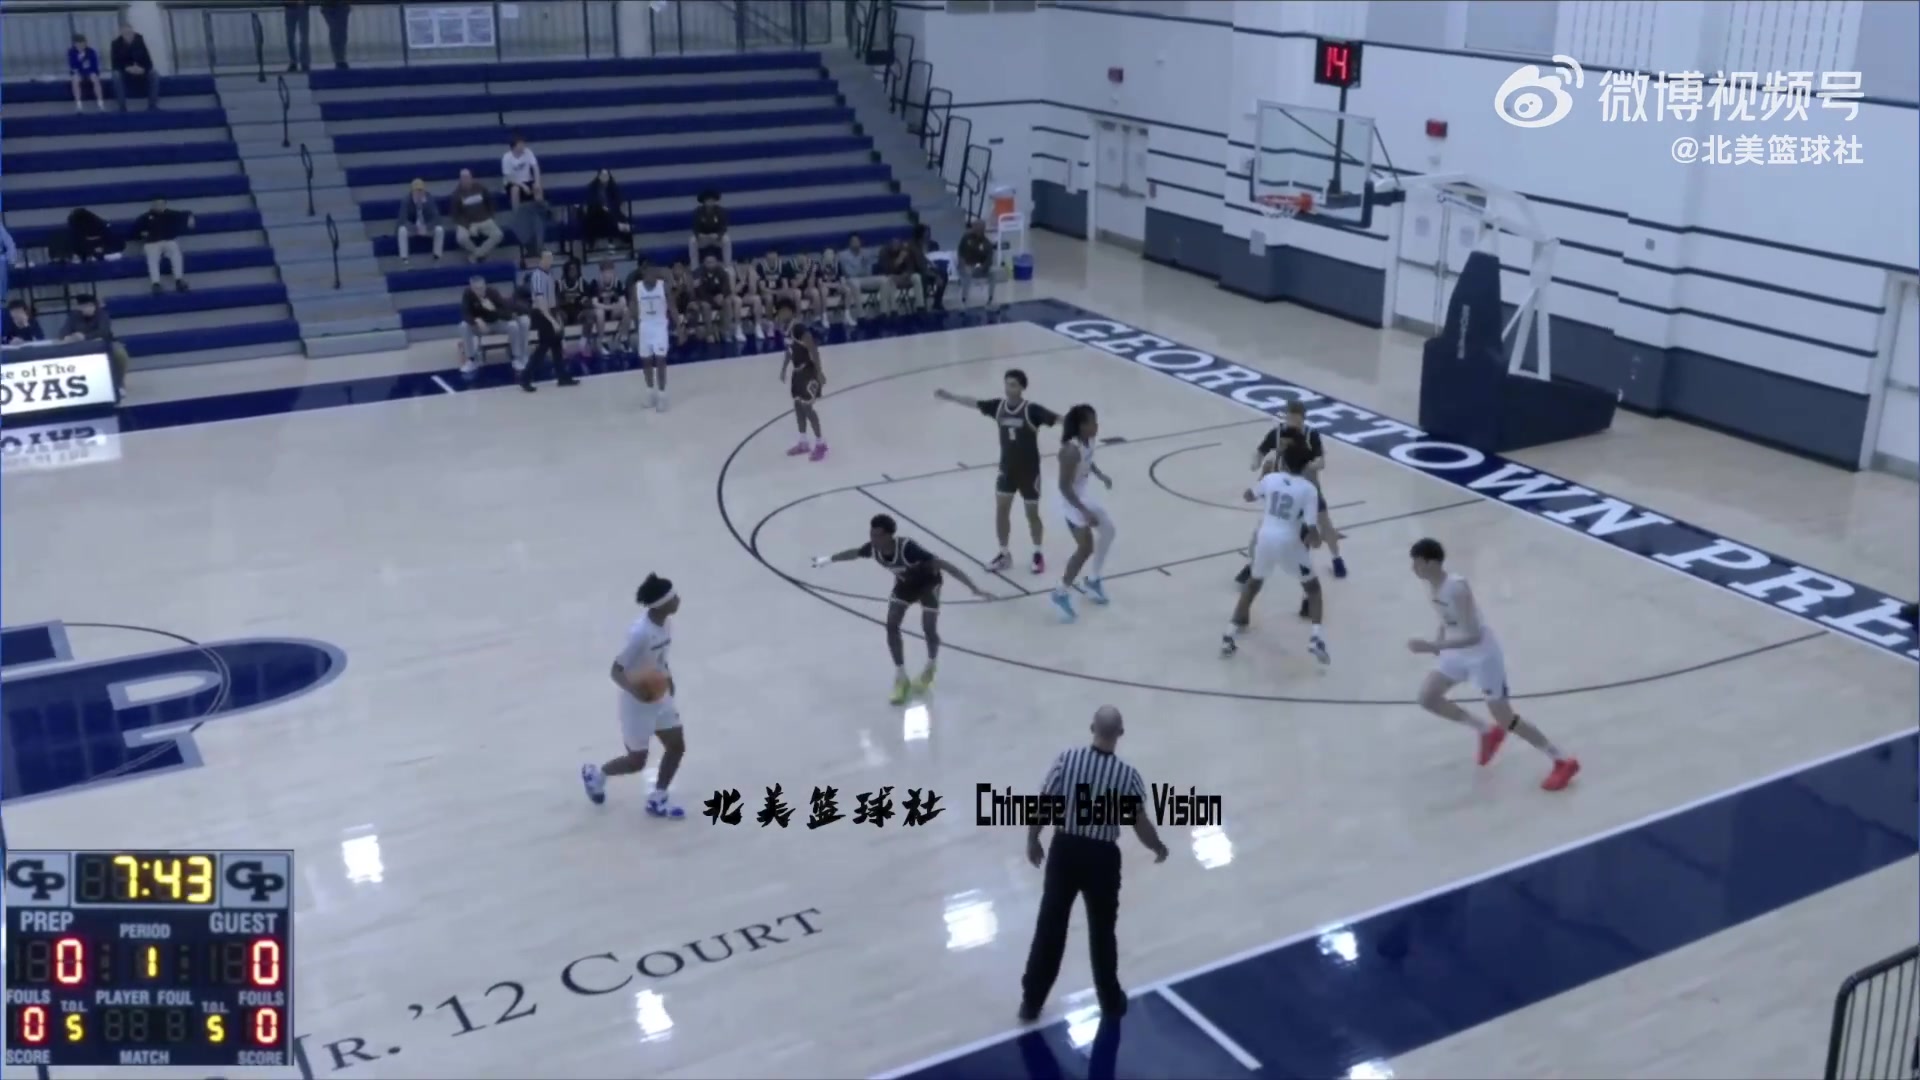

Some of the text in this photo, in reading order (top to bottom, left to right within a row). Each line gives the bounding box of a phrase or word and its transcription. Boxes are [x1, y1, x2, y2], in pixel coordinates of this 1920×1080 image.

[1326, 46, 1348, 80] 14
[43, 363, 76, 376] The
[1054, 318, 1919, 658] GEORGETOWN PRE
[1269, 490, 1294, 521] 12
